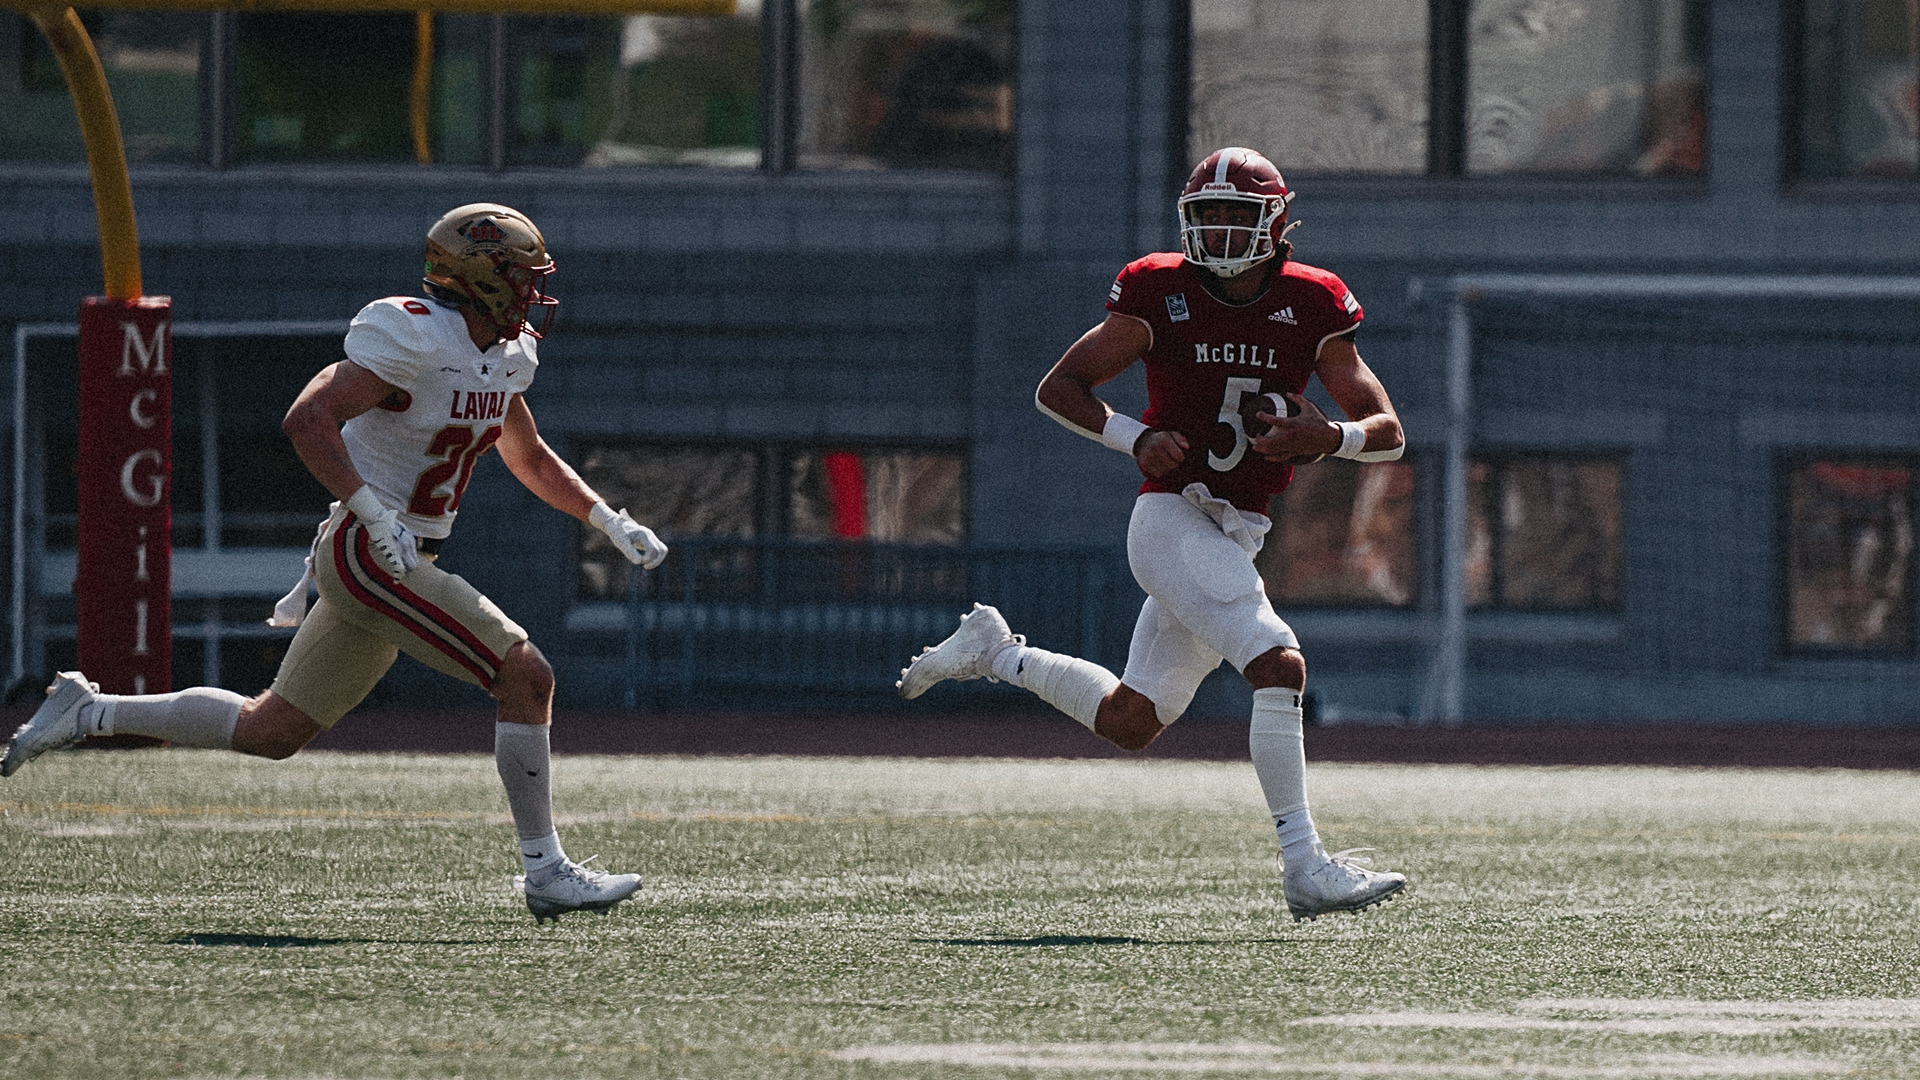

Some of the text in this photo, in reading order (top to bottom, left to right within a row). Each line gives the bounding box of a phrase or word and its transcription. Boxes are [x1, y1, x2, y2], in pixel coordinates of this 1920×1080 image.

[1267, 314, 1298, 326] adidas
[1195, 343, 1278, 369] McGILL
[450, 389, 506, 420] LAVAL
[1207, 376, 1263, 473] 5
